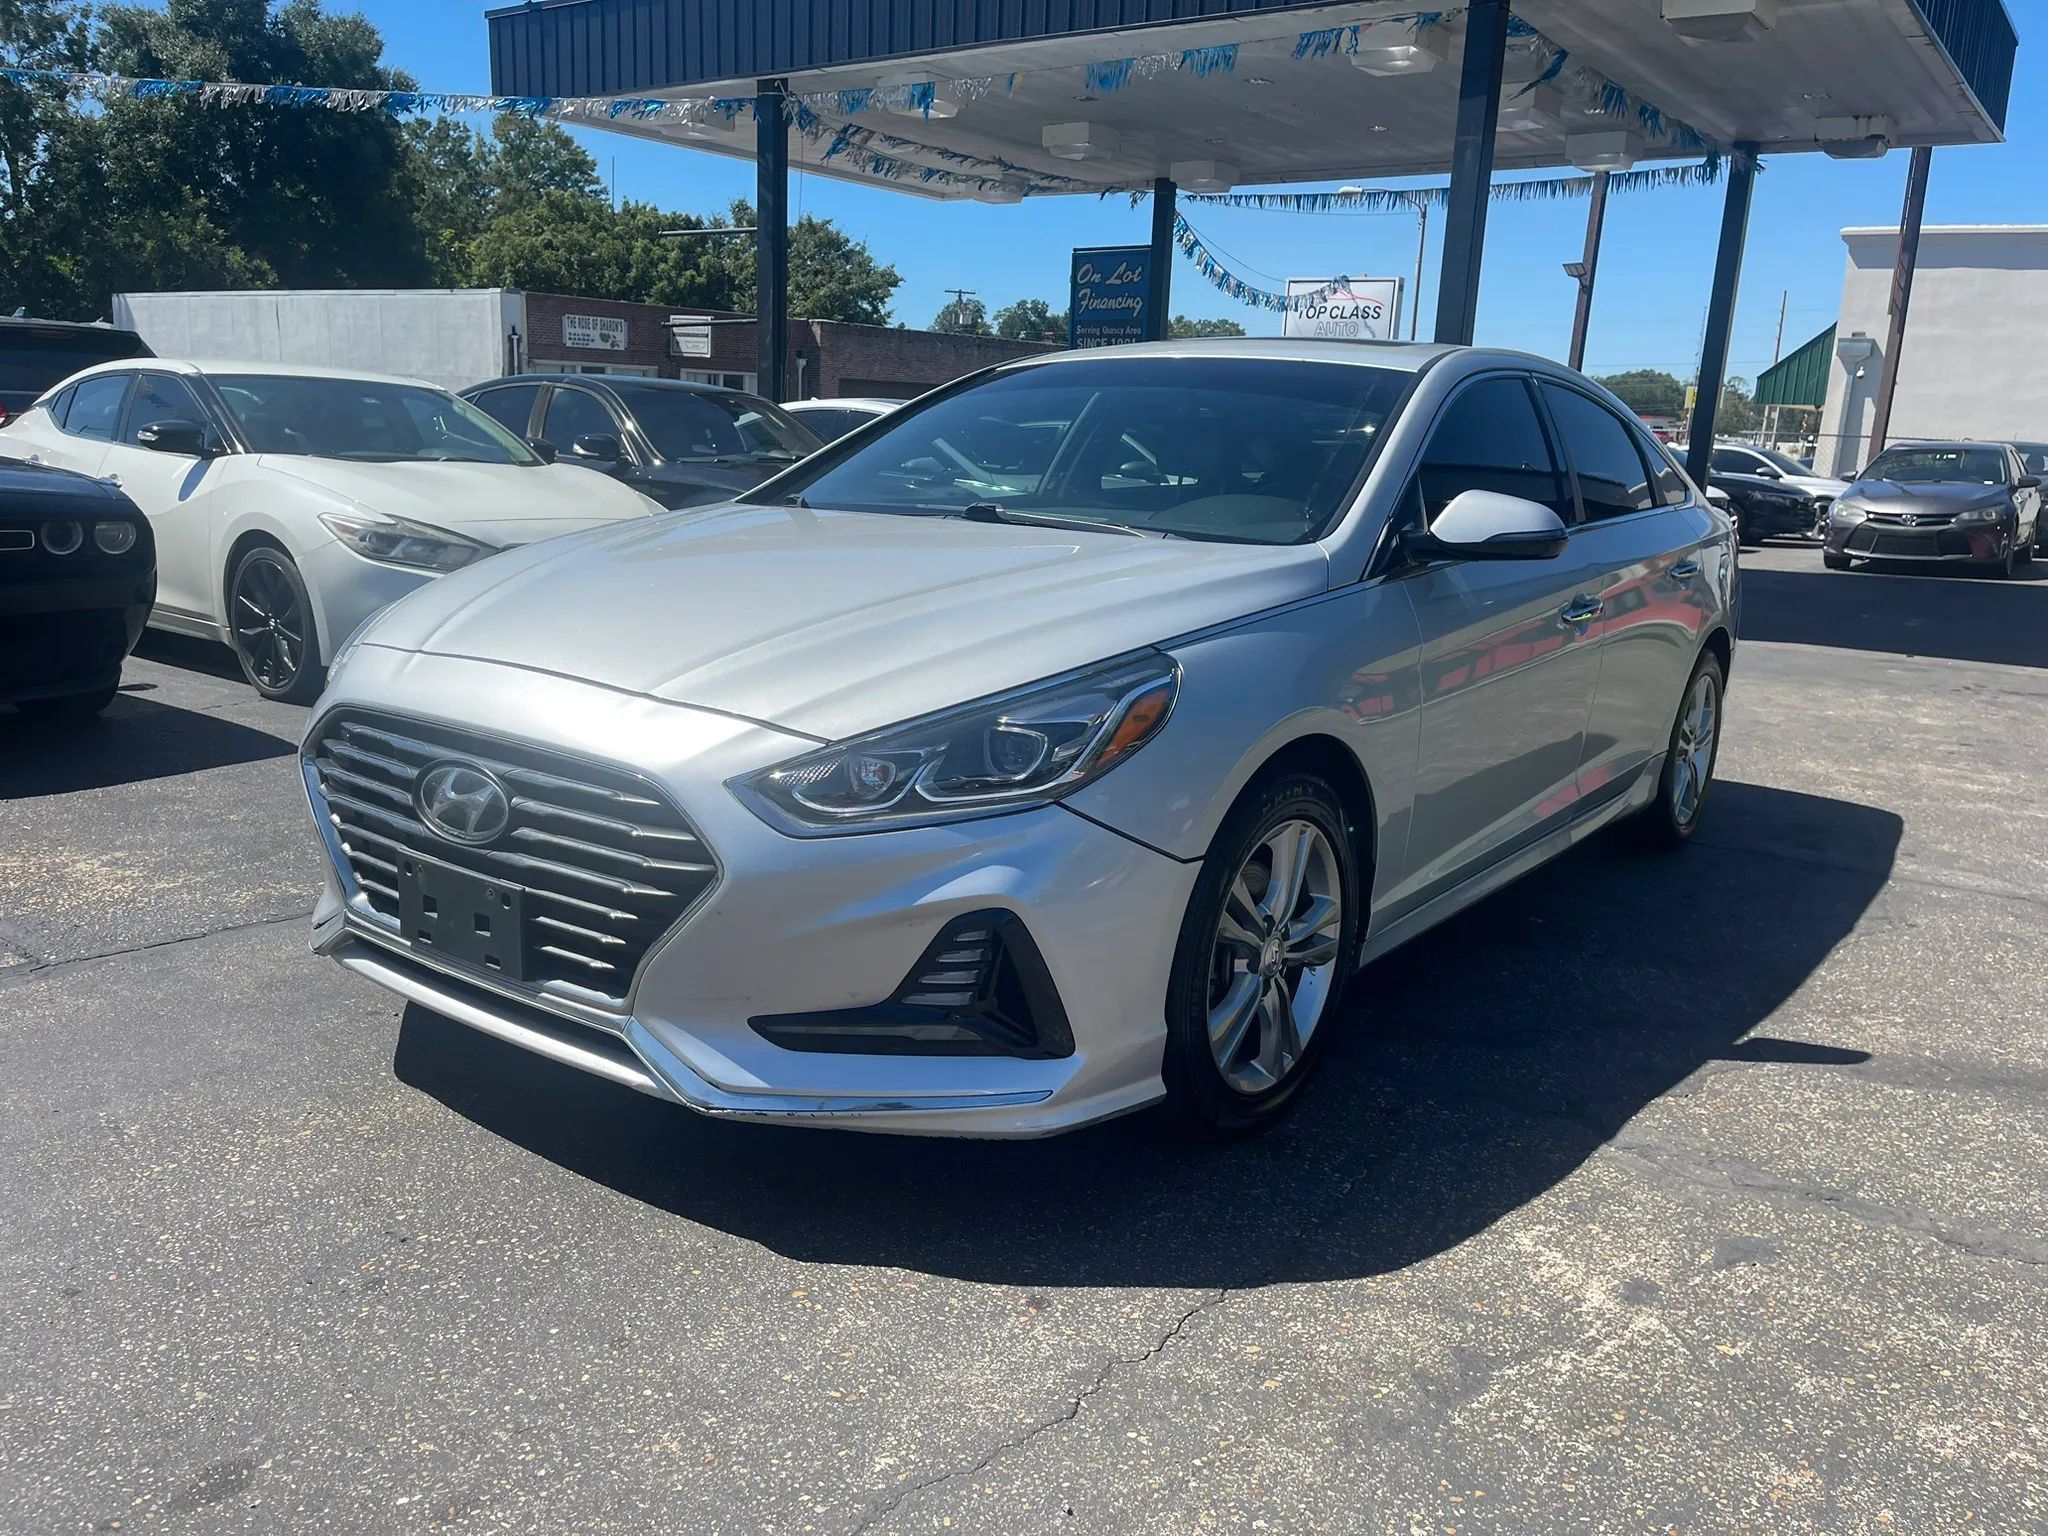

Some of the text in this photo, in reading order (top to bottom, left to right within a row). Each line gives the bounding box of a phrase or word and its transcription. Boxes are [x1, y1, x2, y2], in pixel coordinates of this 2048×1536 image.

[1077, 262, 1142, 285] On Lot
[1078, 287, 1143, 318] Financing
[1299, 305, 1382, 319] TOP CLASS
[566, 315, 577, 329] THE
[578, 316, 591, 330] ROSE
[591, 317, 599, 331] OF
[1076, 325, 1100, 335] Serving
[1125, 326, 1142, 334] Area
[1314, 321, 1359, 337] AUTO
[1077, 338, 1108, 349] SINCE
